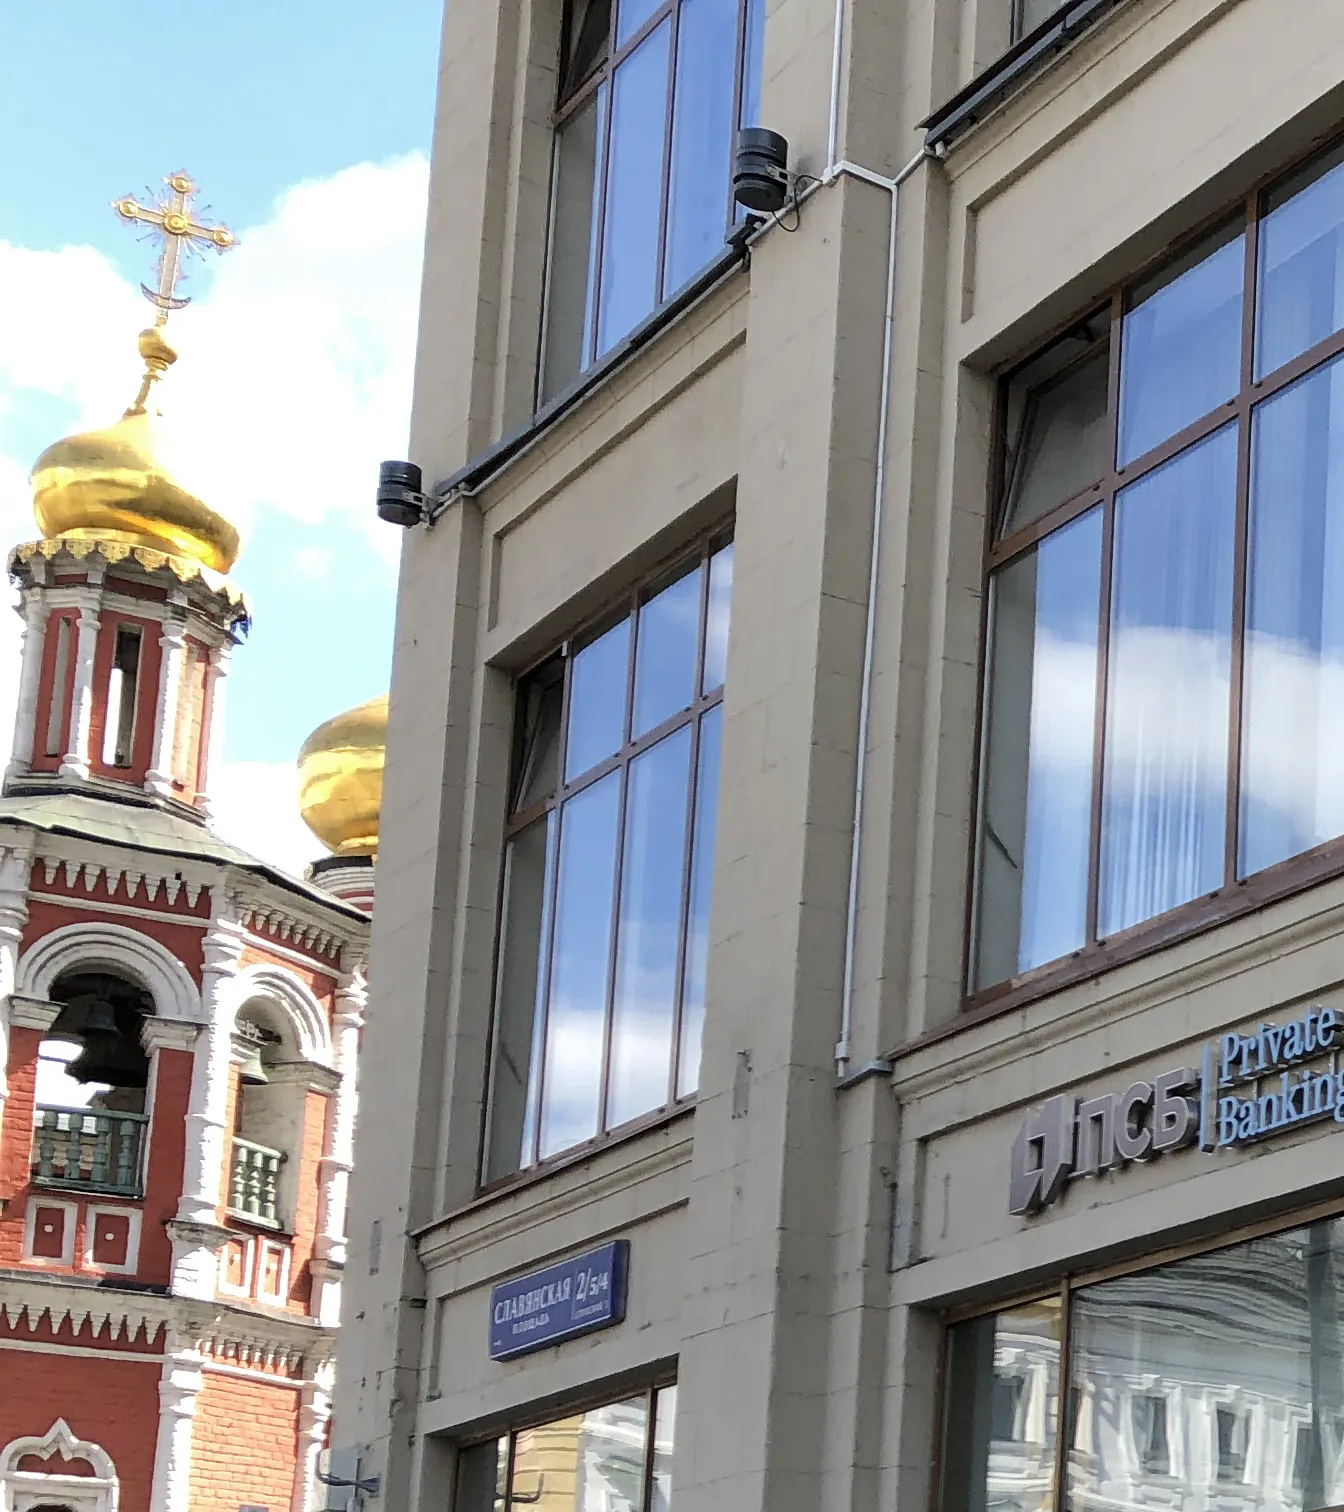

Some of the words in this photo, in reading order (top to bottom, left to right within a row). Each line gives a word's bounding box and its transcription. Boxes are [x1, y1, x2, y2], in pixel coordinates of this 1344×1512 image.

[1219, 1007, 1338, 1083] Private
[1075, 1067, 1198, 1176] ПСБ
[494, 1276, 573, 1325] СЛАВЯНСКАЯ
